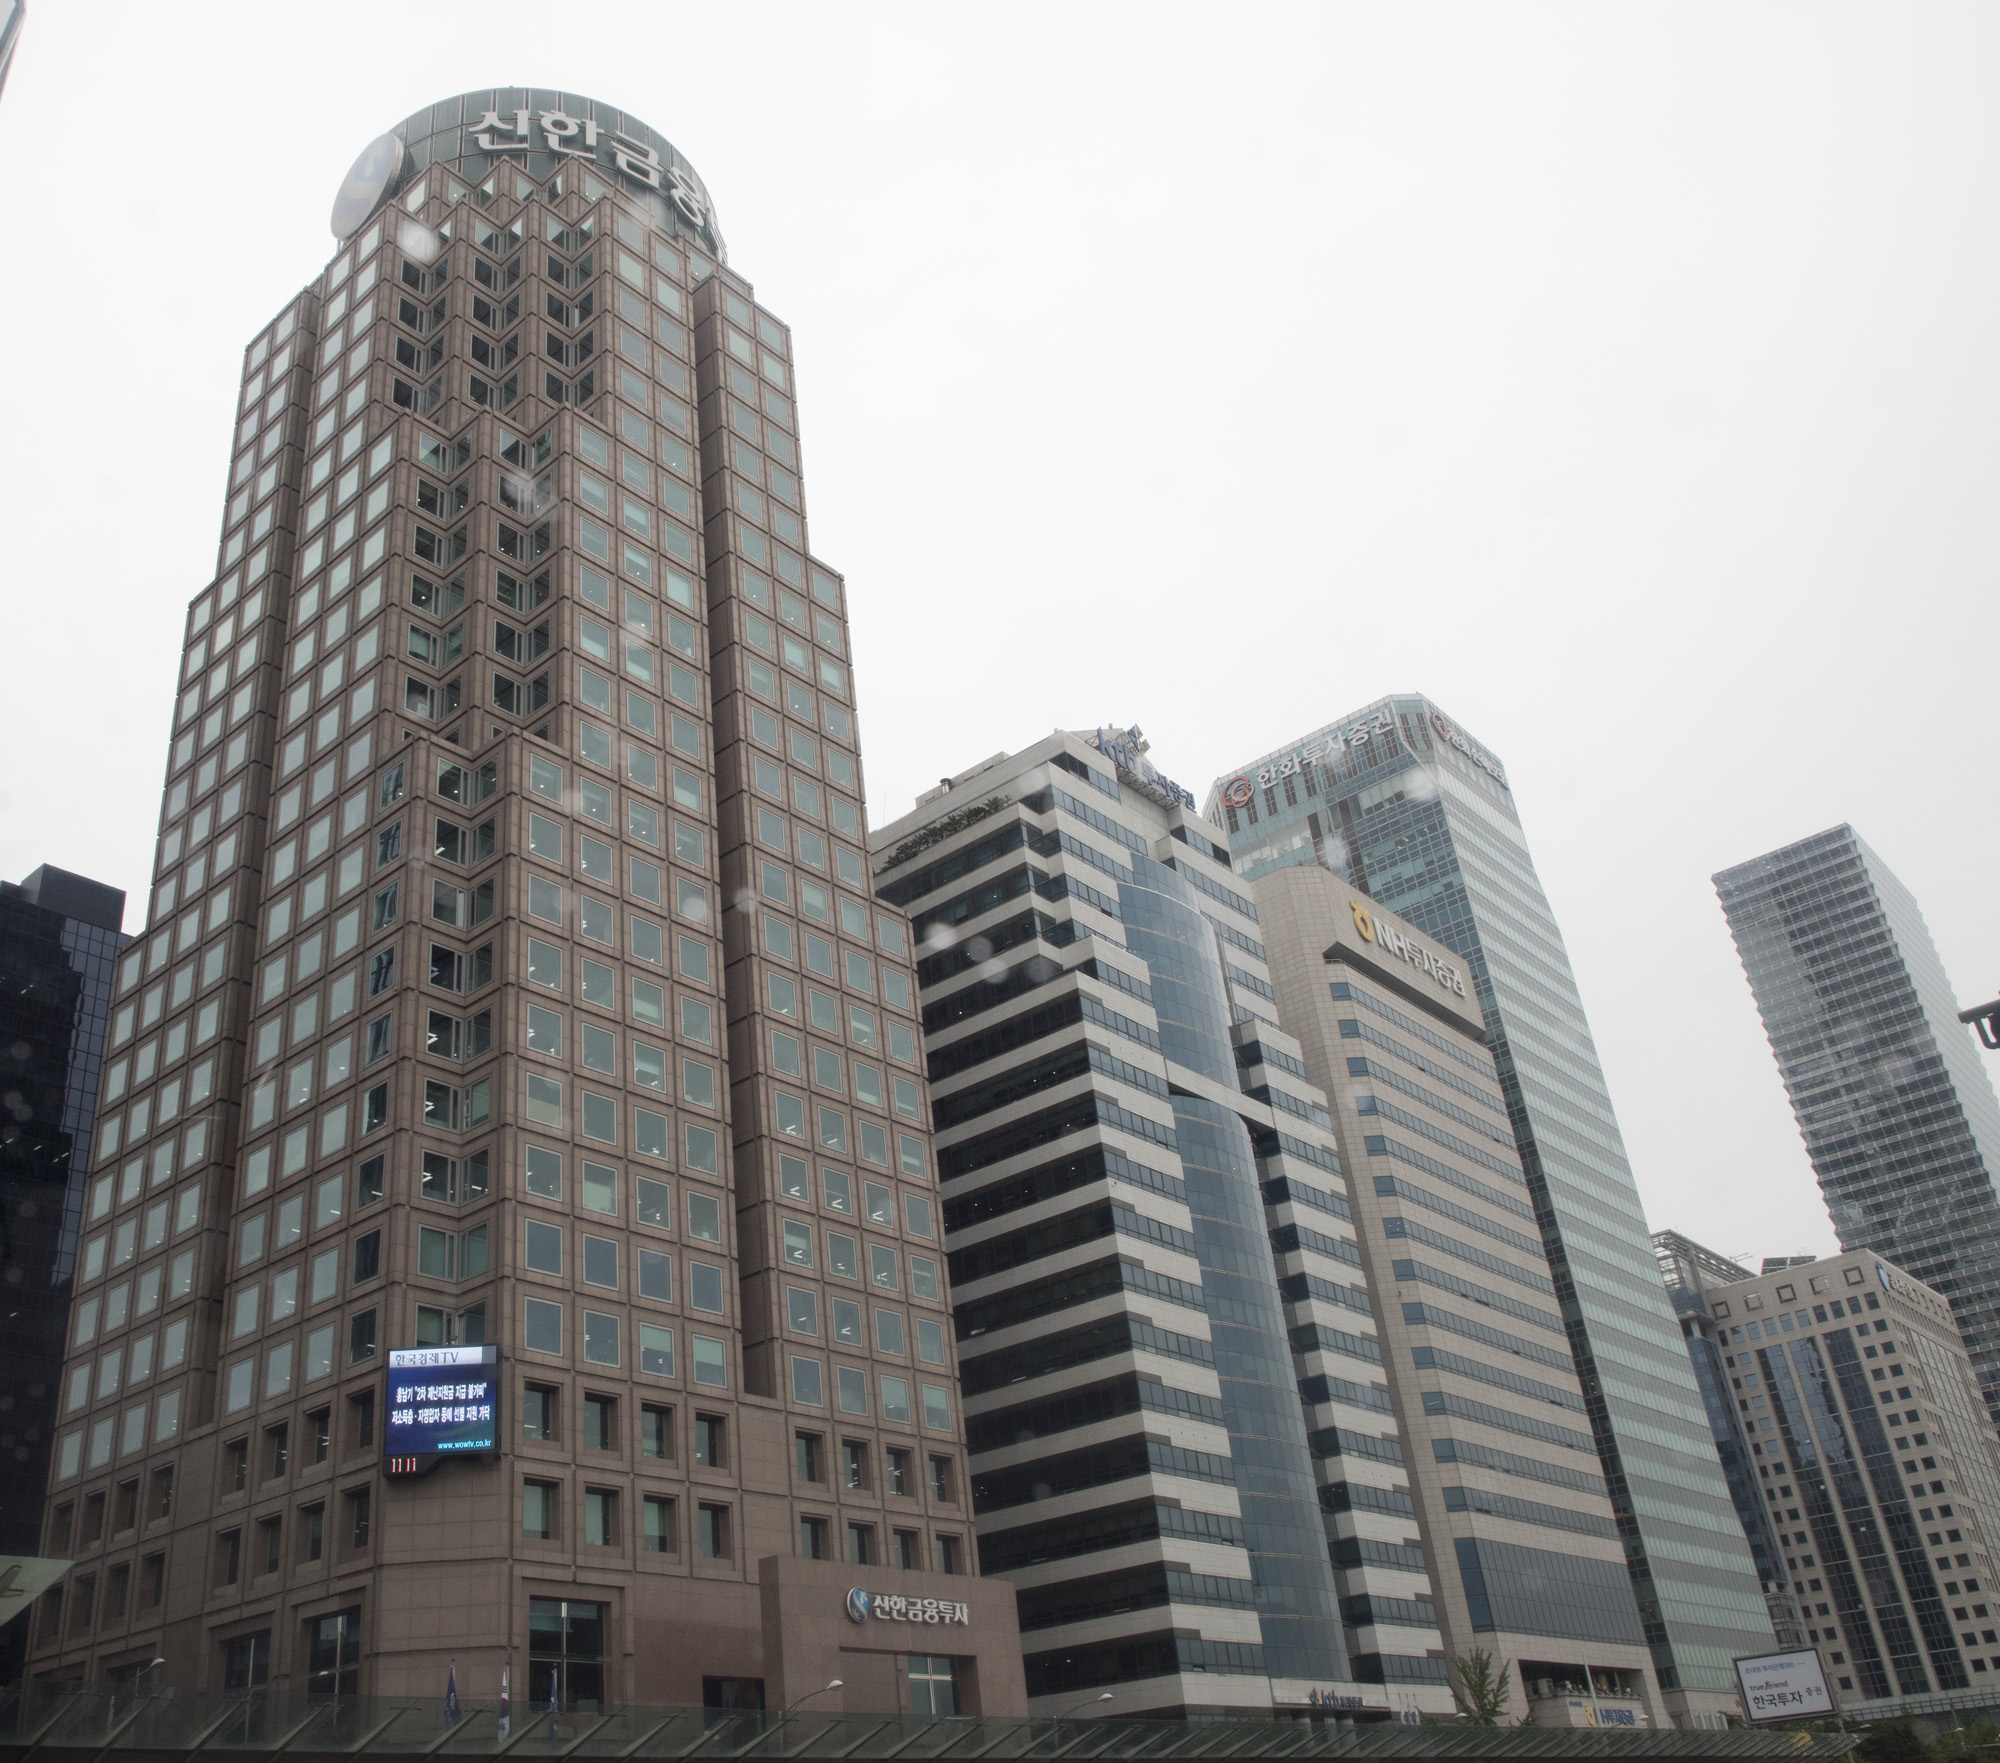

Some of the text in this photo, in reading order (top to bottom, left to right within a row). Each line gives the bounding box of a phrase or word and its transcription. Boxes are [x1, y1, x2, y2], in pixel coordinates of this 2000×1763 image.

[1255, 707, 1394, 790] 한화투자증권
[1373, 917, 1466, 997] NH투자증권
[395, 1352, 459, 1366] 한국경제TV
[427, 1385, 454, 1400] 재난지원금
[455, 1384, 466, 1399] 지급
[438, 1439, 491, 1449] www.wowtv.co.kr
[873, 1594, 969, 1625] 신한금융투자
[1752, 1686, 1822, 1710] 한국투자 증권
